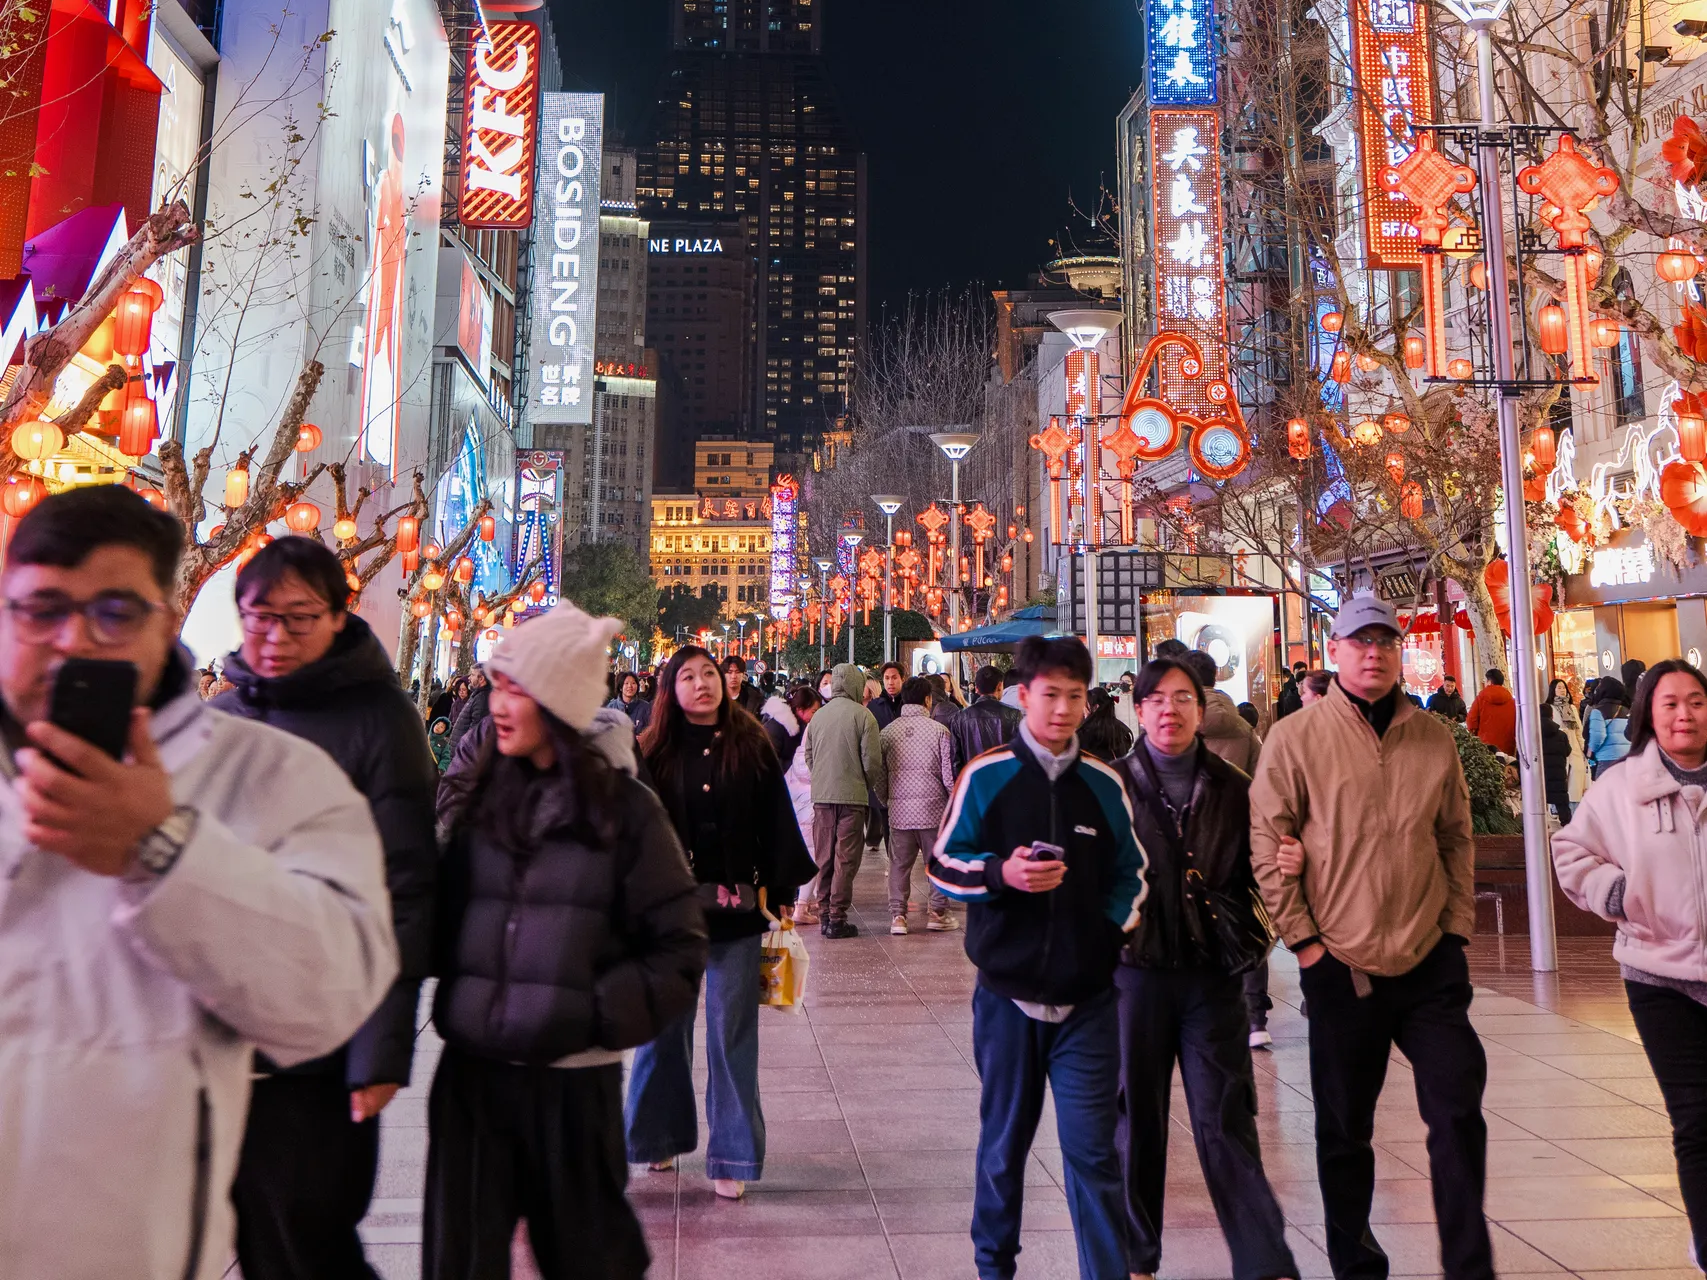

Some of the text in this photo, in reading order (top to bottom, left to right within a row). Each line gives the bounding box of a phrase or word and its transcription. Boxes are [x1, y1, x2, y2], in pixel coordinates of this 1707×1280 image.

[468, 36, 528, 201] KFC
[549, 117, 586, 347] BOSIDENG
[648, 239, 723, 253] NE PLAZA
[541, 364, 582, 385] 世界
[541, 386, 582, 406] 名牌
